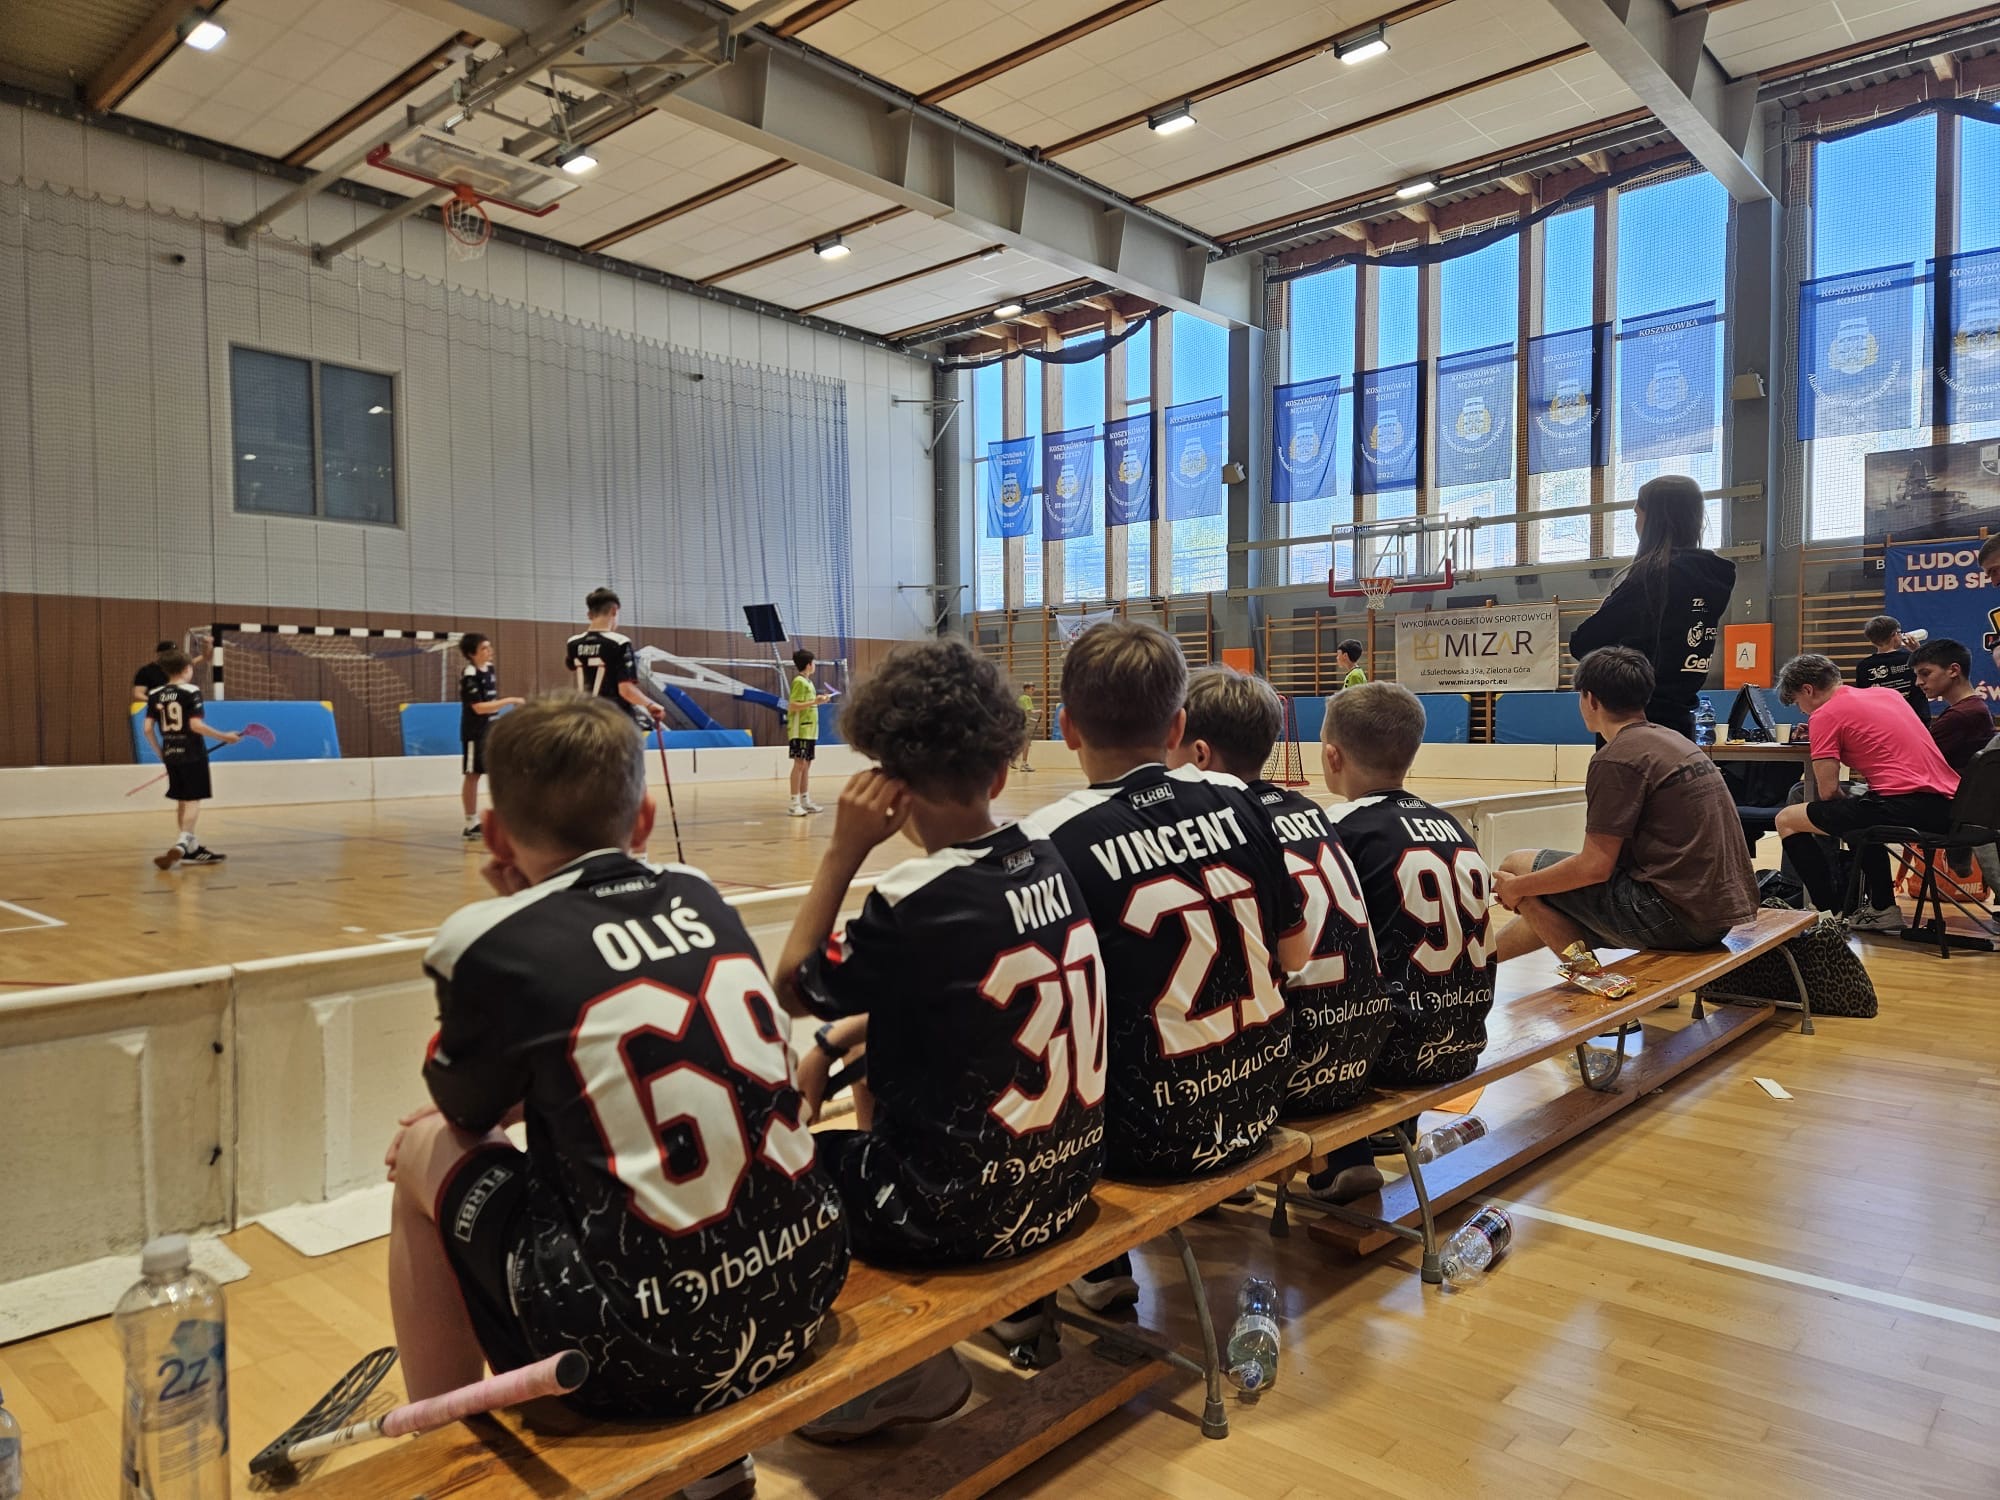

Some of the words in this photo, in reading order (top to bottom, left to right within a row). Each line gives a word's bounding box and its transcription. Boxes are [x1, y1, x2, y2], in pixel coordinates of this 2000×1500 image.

[1639, 318, 1699, 337] KOSZYKÓWKA
[1898, 574, 1959, 593] KLUB
[1402, 618, 1450, 629] WYKONAWCA
[1495, 612, 1552, 624] SPORTOWYCH
[1445, 630, 1533, 657] MIZAR
[1738, 648, 1749, 662] A
[573, 657, 606, 698] 17
[1438, 678, 1508, 687] www.mizarsport.eu
[1486, 667, 1512, 675] Zielona
[1513, 666, 1531, 674] Góra
[156, 701, 183, 733] 19
[1131, 785, 1174, 807] FLRBL
[1089, 806, 1248, 881] VINCENT
[1400, 816, 1463, 843] LEON
[1005, 873, 1073, 934] MIKI
[1394, 847, 1497, 976] 99
[592, 896, 716, 971] OLIŚ
[1121, 864, 1287, 1058] 21
[977, 918, 1107, 1138] 30
[1339, 1059, 1367, 1082] EKO
[567, 954, 817, 1237] 69
[457, 1169, 507, 1234] FLRBL
